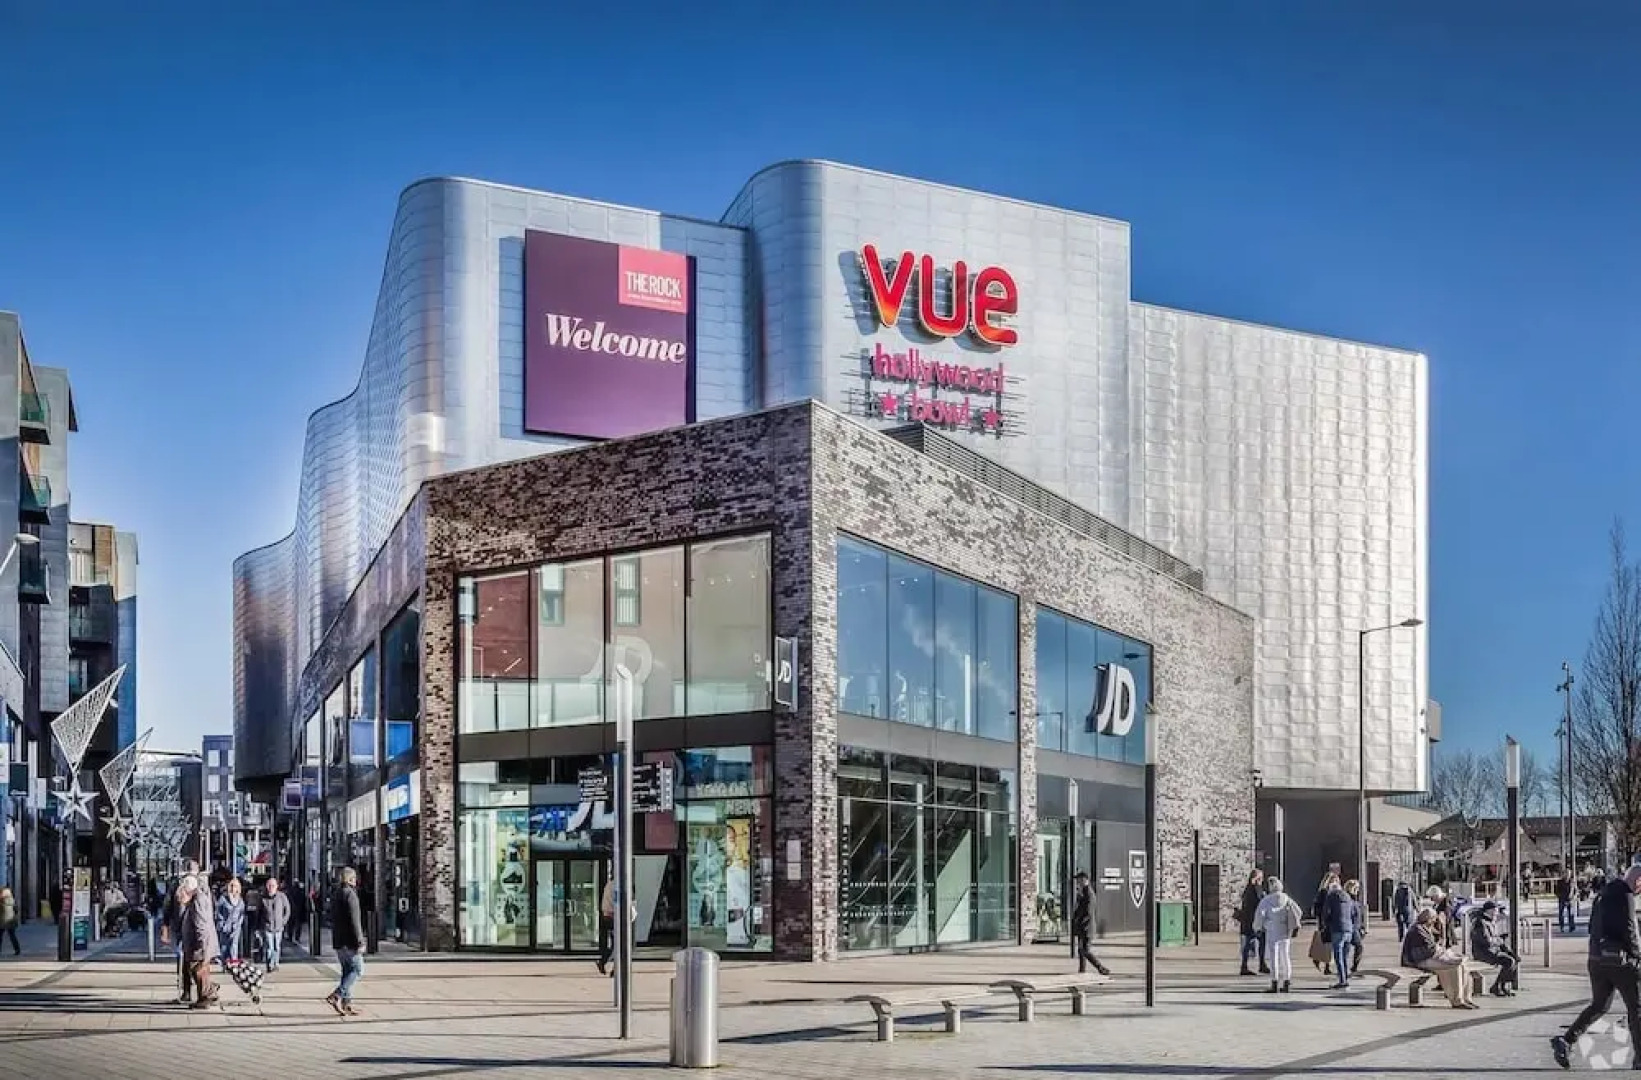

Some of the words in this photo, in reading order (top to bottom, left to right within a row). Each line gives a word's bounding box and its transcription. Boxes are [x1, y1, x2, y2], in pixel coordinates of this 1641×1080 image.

[546, 312, 687, 364] Welcome
[872, 342, 1005, 393] hollywood
[910, 391, 970, 427] bowl
[1095, 662, 1136, 736] JD
